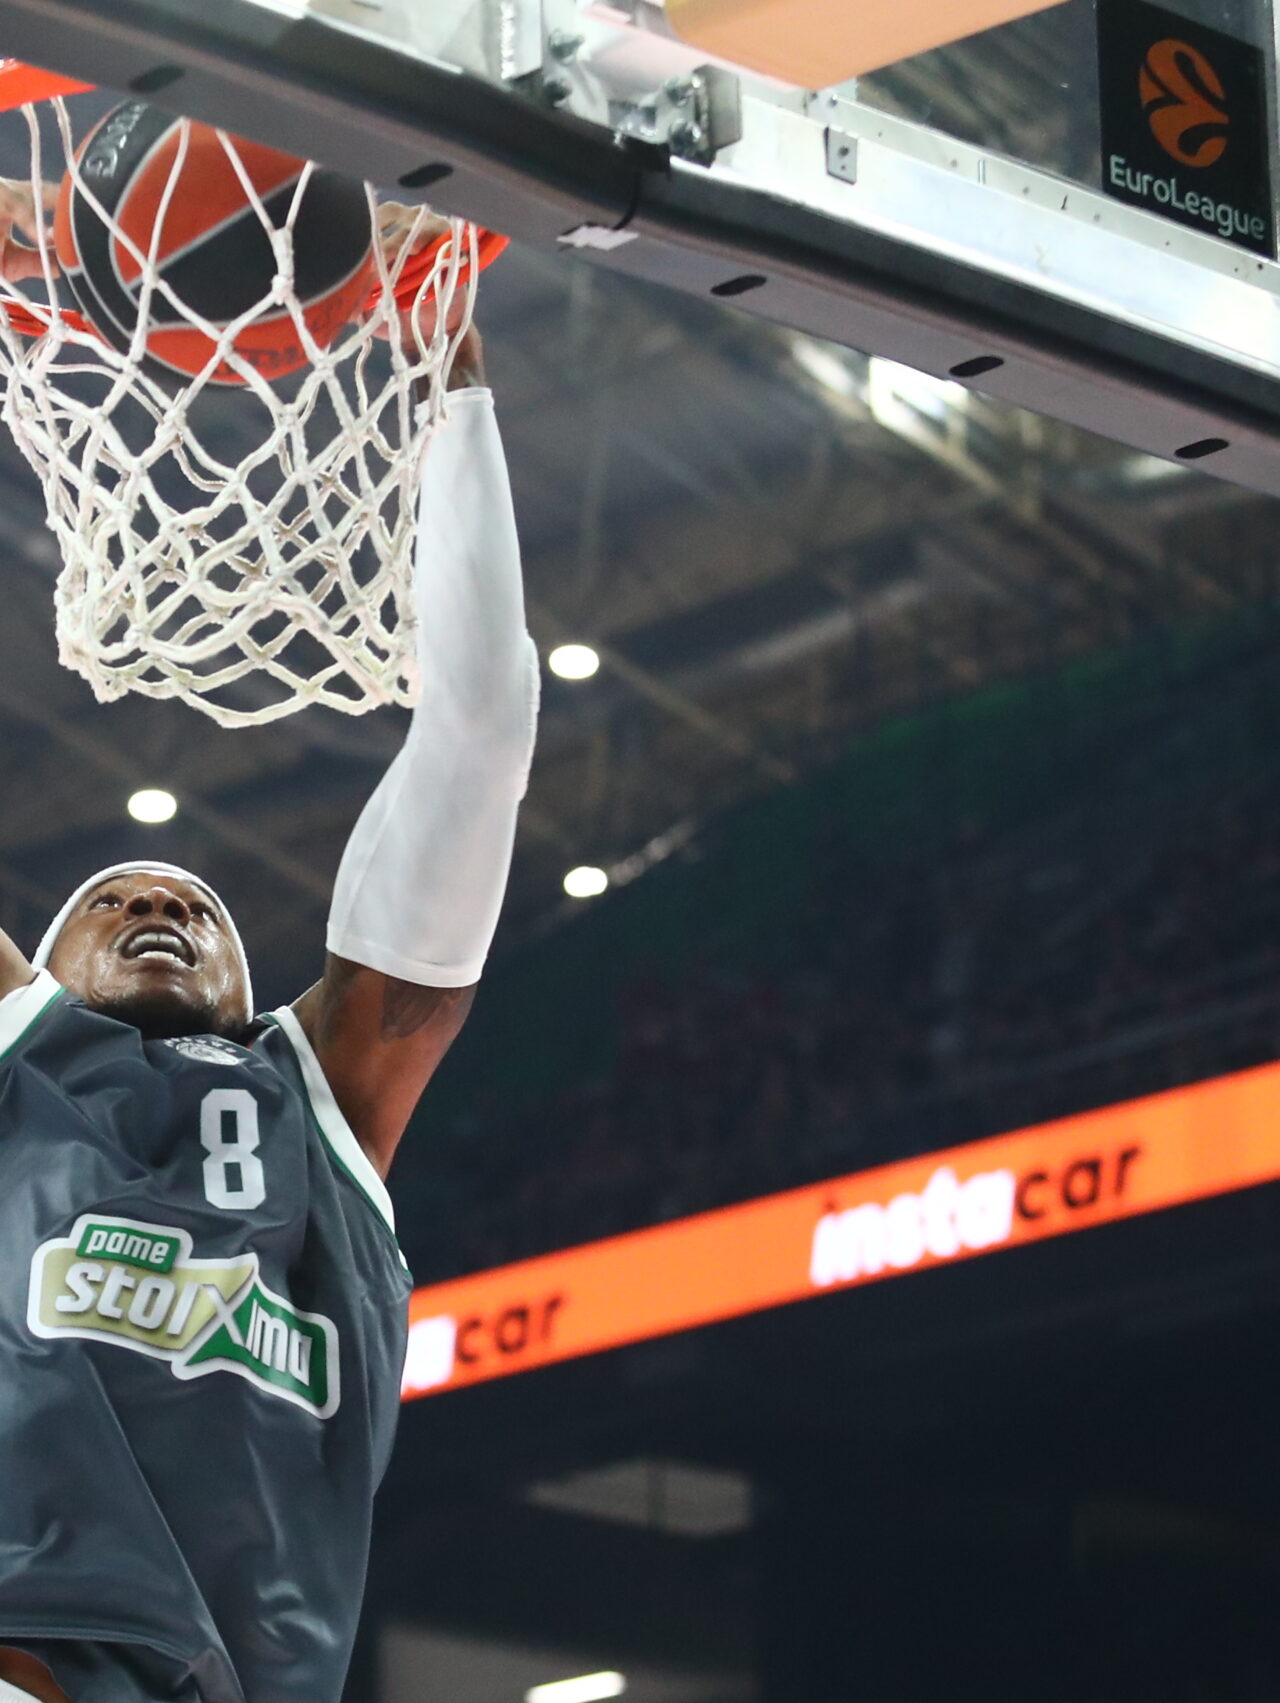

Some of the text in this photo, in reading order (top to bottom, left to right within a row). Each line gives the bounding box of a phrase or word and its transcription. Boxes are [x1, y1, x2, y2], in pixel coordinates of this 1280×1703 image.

[1109, 154, 1265, 240] EuroLeague
[200, 1088, 266, 1210] 8
[85, 1229, 170, 1264] pame
